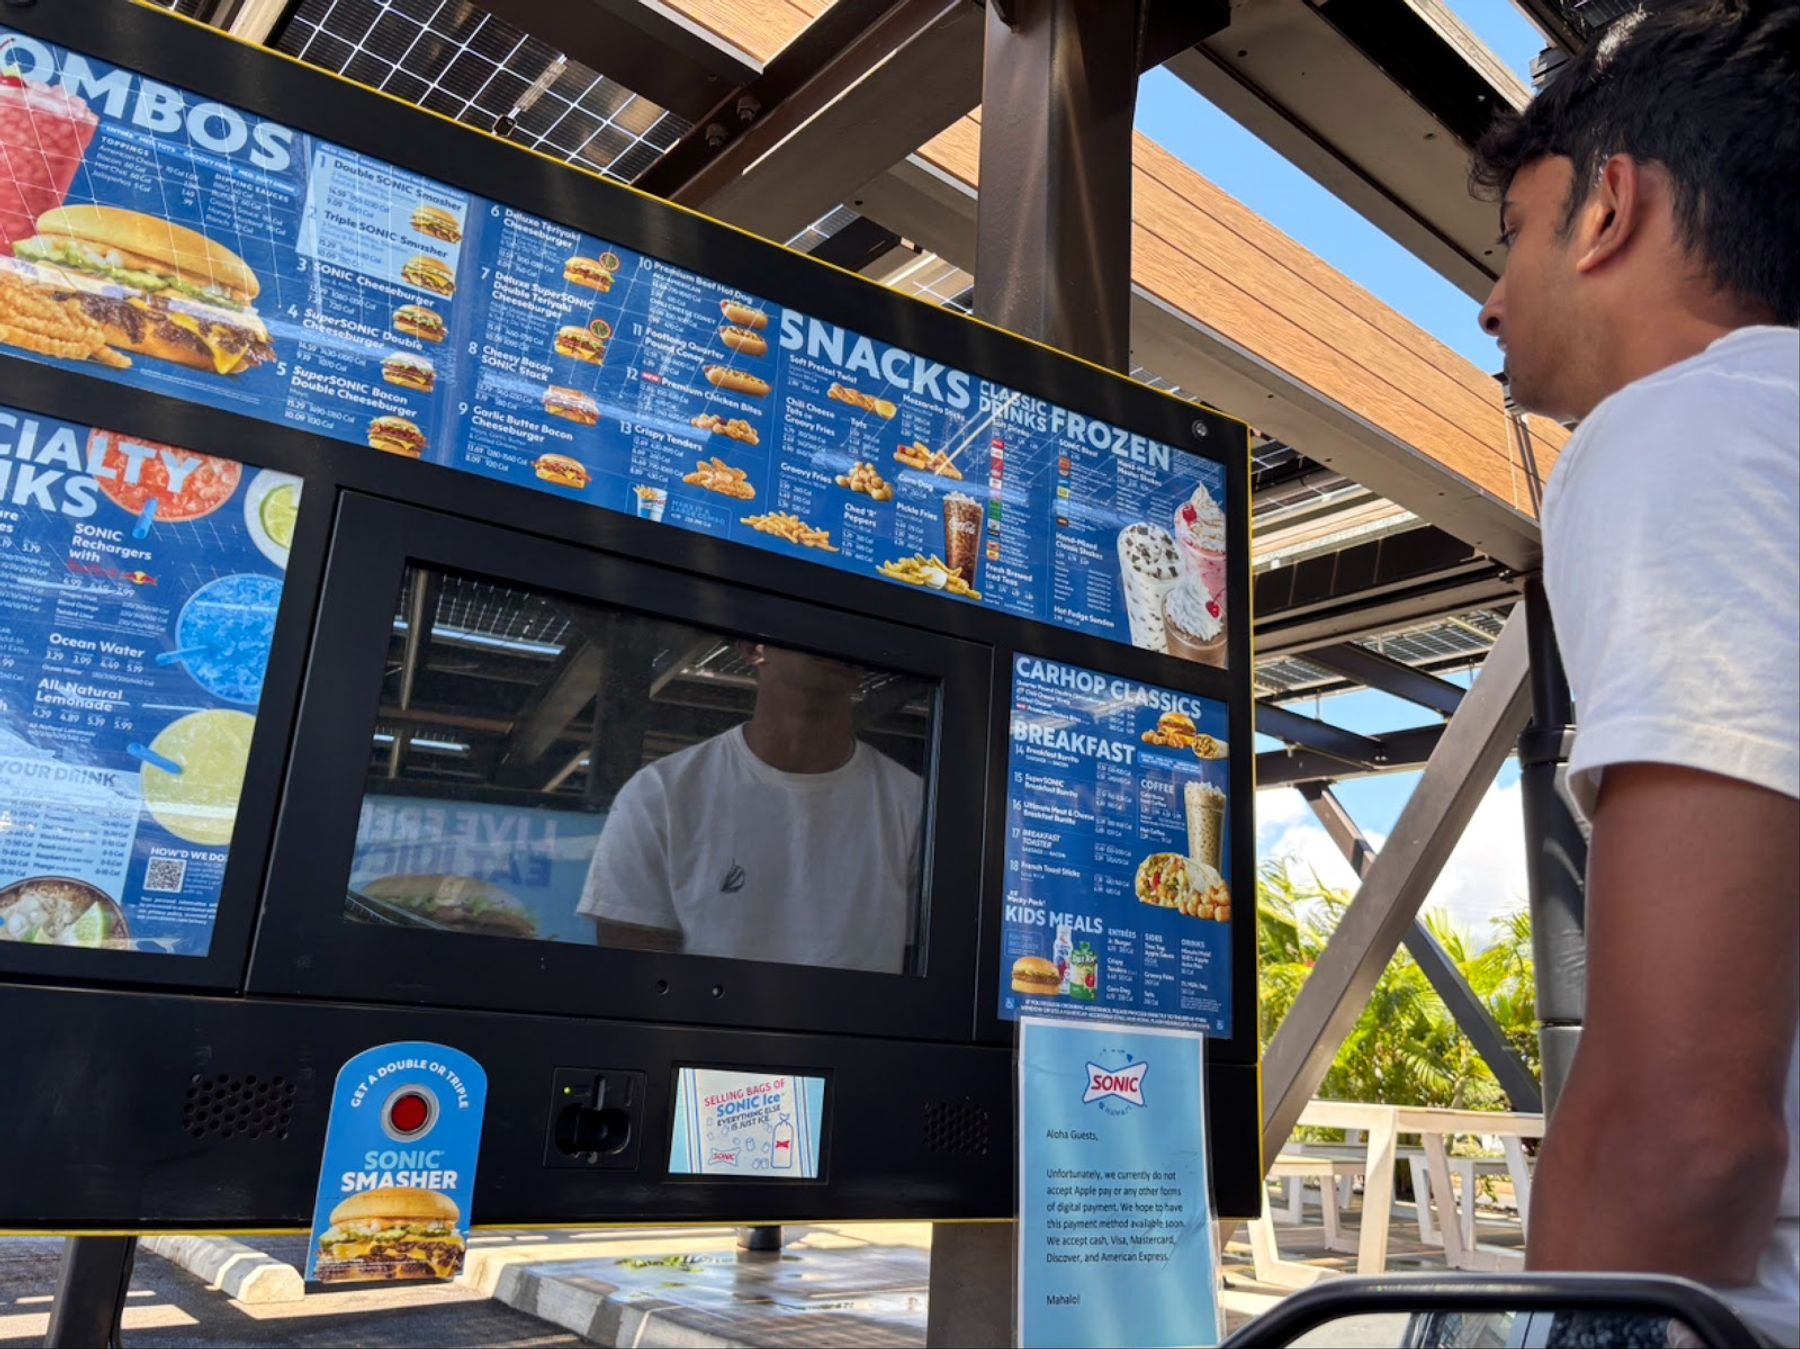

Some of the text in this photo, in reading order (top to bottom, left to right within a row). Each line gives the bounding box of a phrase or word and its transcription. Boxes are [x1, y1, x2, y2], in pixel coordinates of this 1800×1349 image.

[333, 159, 375, 181] Double
[376, 173, 412, 195] SONIC
[416, 188, 462, 211] Smasher
[324, 209, 357, 230] Triple
[358, 221, 397, 242] SONIC
[400, 236, 447, 258] Smasher
[490, 205, 580, 243] 6 Deluxe Teriyaki
[503, 218, 573, 249] Cheeseburger
[297, 257, 308, 272] 3
[313, 260, 353, 282] SONIC
[357, 275, 436, 307] Cheeseburger
[481, 266, 594, 311] 7 Deluxe SuperSONIC
[639, 257, 653, 271] 10
[654, 261, 695, 284] Premium
[695, 275, 717, 291] Beef
[717, 283, 734, 297] Hot
[734, 290, 753, 305] Dog
[491, 290, 562, 320] Cheeseburger
[493, 280, 572, 313] Double Teriyaki
[287, 304, 424, 351] 4 SuperSONIC Double
[302, 319, 385, 350] Cheeseburger
[632, 322, 725, 360] 11 Footlong Quarter
[468, 341, 554, 373] 8 Cheesy Bacon
[645, 337, 705, 364] Pound Coney
[780, 308, 971, 410] SNACKS
[481, 354, 548, 382] SONIC Stack
[790, 354, 808, 367] Soft
[808, 360, 836, 377] Pretzel
[835, 369, 858, 385] Twist
[276, 362, 408, 405] 5 SuperSONIC Bacon
[291, 376, 418, 419] Double Cheeseburger
[627, 367, 638, 381] 12
[662, 376, 703, 398] Premium
[704, 390, 740, 409] Chicken
[740, 402, 763, 417] Bites
[785, 396, 836, 419] Chili Cheese
[980, 380, 1047, 418] CLASSIC
[458, 402, 573, 441] 9 Garlic Butter Bacon
[784, 413, 836, 437] Groovy Fries
[979, 394, 1048, 433] DRINKS
[471, 415, 545, 442] Cheeseburger
[620, 420, 704, 452] 13 Crispy Tenders
[1051, 404, 1170, 472] FROZEN
[781, 461, 833, 485] Groovy Fries
[0, 459, 99, 518] KS
[896, 501, 939, 522] Pickle Fries
[73, 522, 123, 543] SONIC
[69, 549, 101, 564] with
[72, 535, 153, 561] Rechargers
[48, 632, 146, 659] Ocean Water
[35, 690, 114, 713] Lemonade
[38, 677, 124, 701] All-Natural
[1015, 656, 1107, 695] CARHOP
[1110, 680, 1202, 720] CLASSICS
[1013, 719, 1136, 766] BREAKFAST
[53, 765, 119, 788] DRINK
[1140, 779, 1176, 794] COFFEE
[150, 846, 208, 861] HOW'D WE
[1004, 904, 1104, 935] KIDS MEALS
[351, 1059, 470, 1110] GET A DOUBLE OR TRIPLE
[704, 1079, 785, 1108] SELLING BAGS OF
[1091, 1074, 1139, 1093] SONIC
[716, 1092, 782, 1118] SONIC Ice
[716, 1103, 782, 1128] EVERYTHING ELSE
[730, 1113, 770, 1131] IS JUST ICE
[1046, 1129, 1099, 1142] Aloha Guests,
[364, 1150, 441, 1171] SONIC
[340, 1169, 459, 1193] SMASHER
[1046, 1169, 1176, 1182] Unfortunately, we currently do not
[1046, 1185, 1182, 1199] accept Apple pay or any other forms
[1046, 1202, 1183, 1215] of digital payment. We hope to have
[1046, 1218, 1186, 1231] this payment method available soon.
[1046, 1234, 1177, 1247] We accept cash, Visa, Mastercard,
[1046, 1250, 1170, 1264] Discover, and American Express.
[1046, 1293, 1082, 1305] Mahalo!
